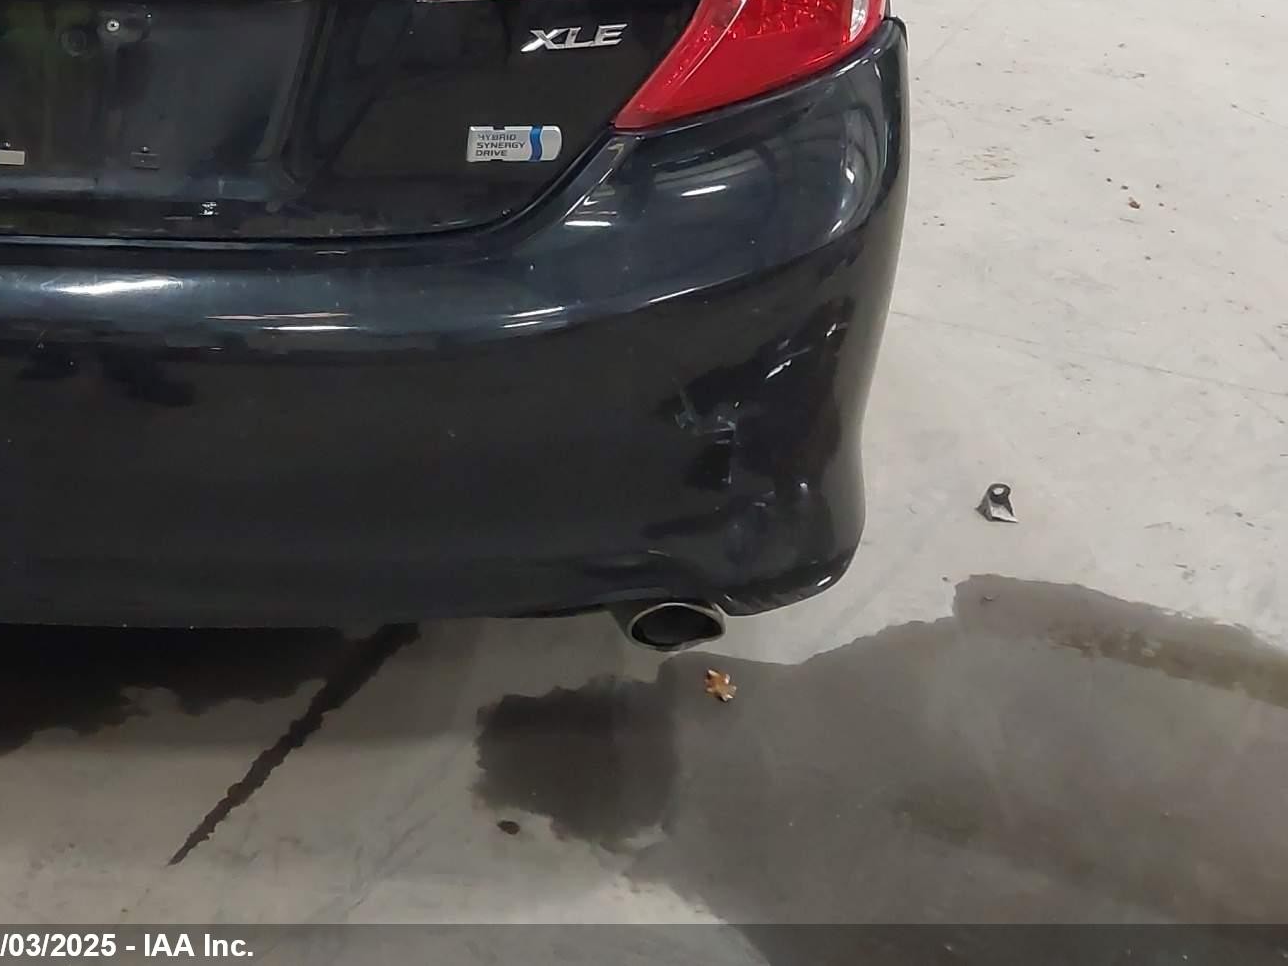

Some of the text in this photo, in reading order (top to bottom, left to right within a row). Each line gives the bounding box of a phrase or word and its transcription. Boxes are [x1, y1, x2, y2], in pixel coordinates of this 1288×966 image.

[521, 23, 628, 52] XLE
[477, 133, 517, 142] HYBRID
[476, 141, 526, 150] SYNERGY
[475, 149, 508, 158] DRIVE
